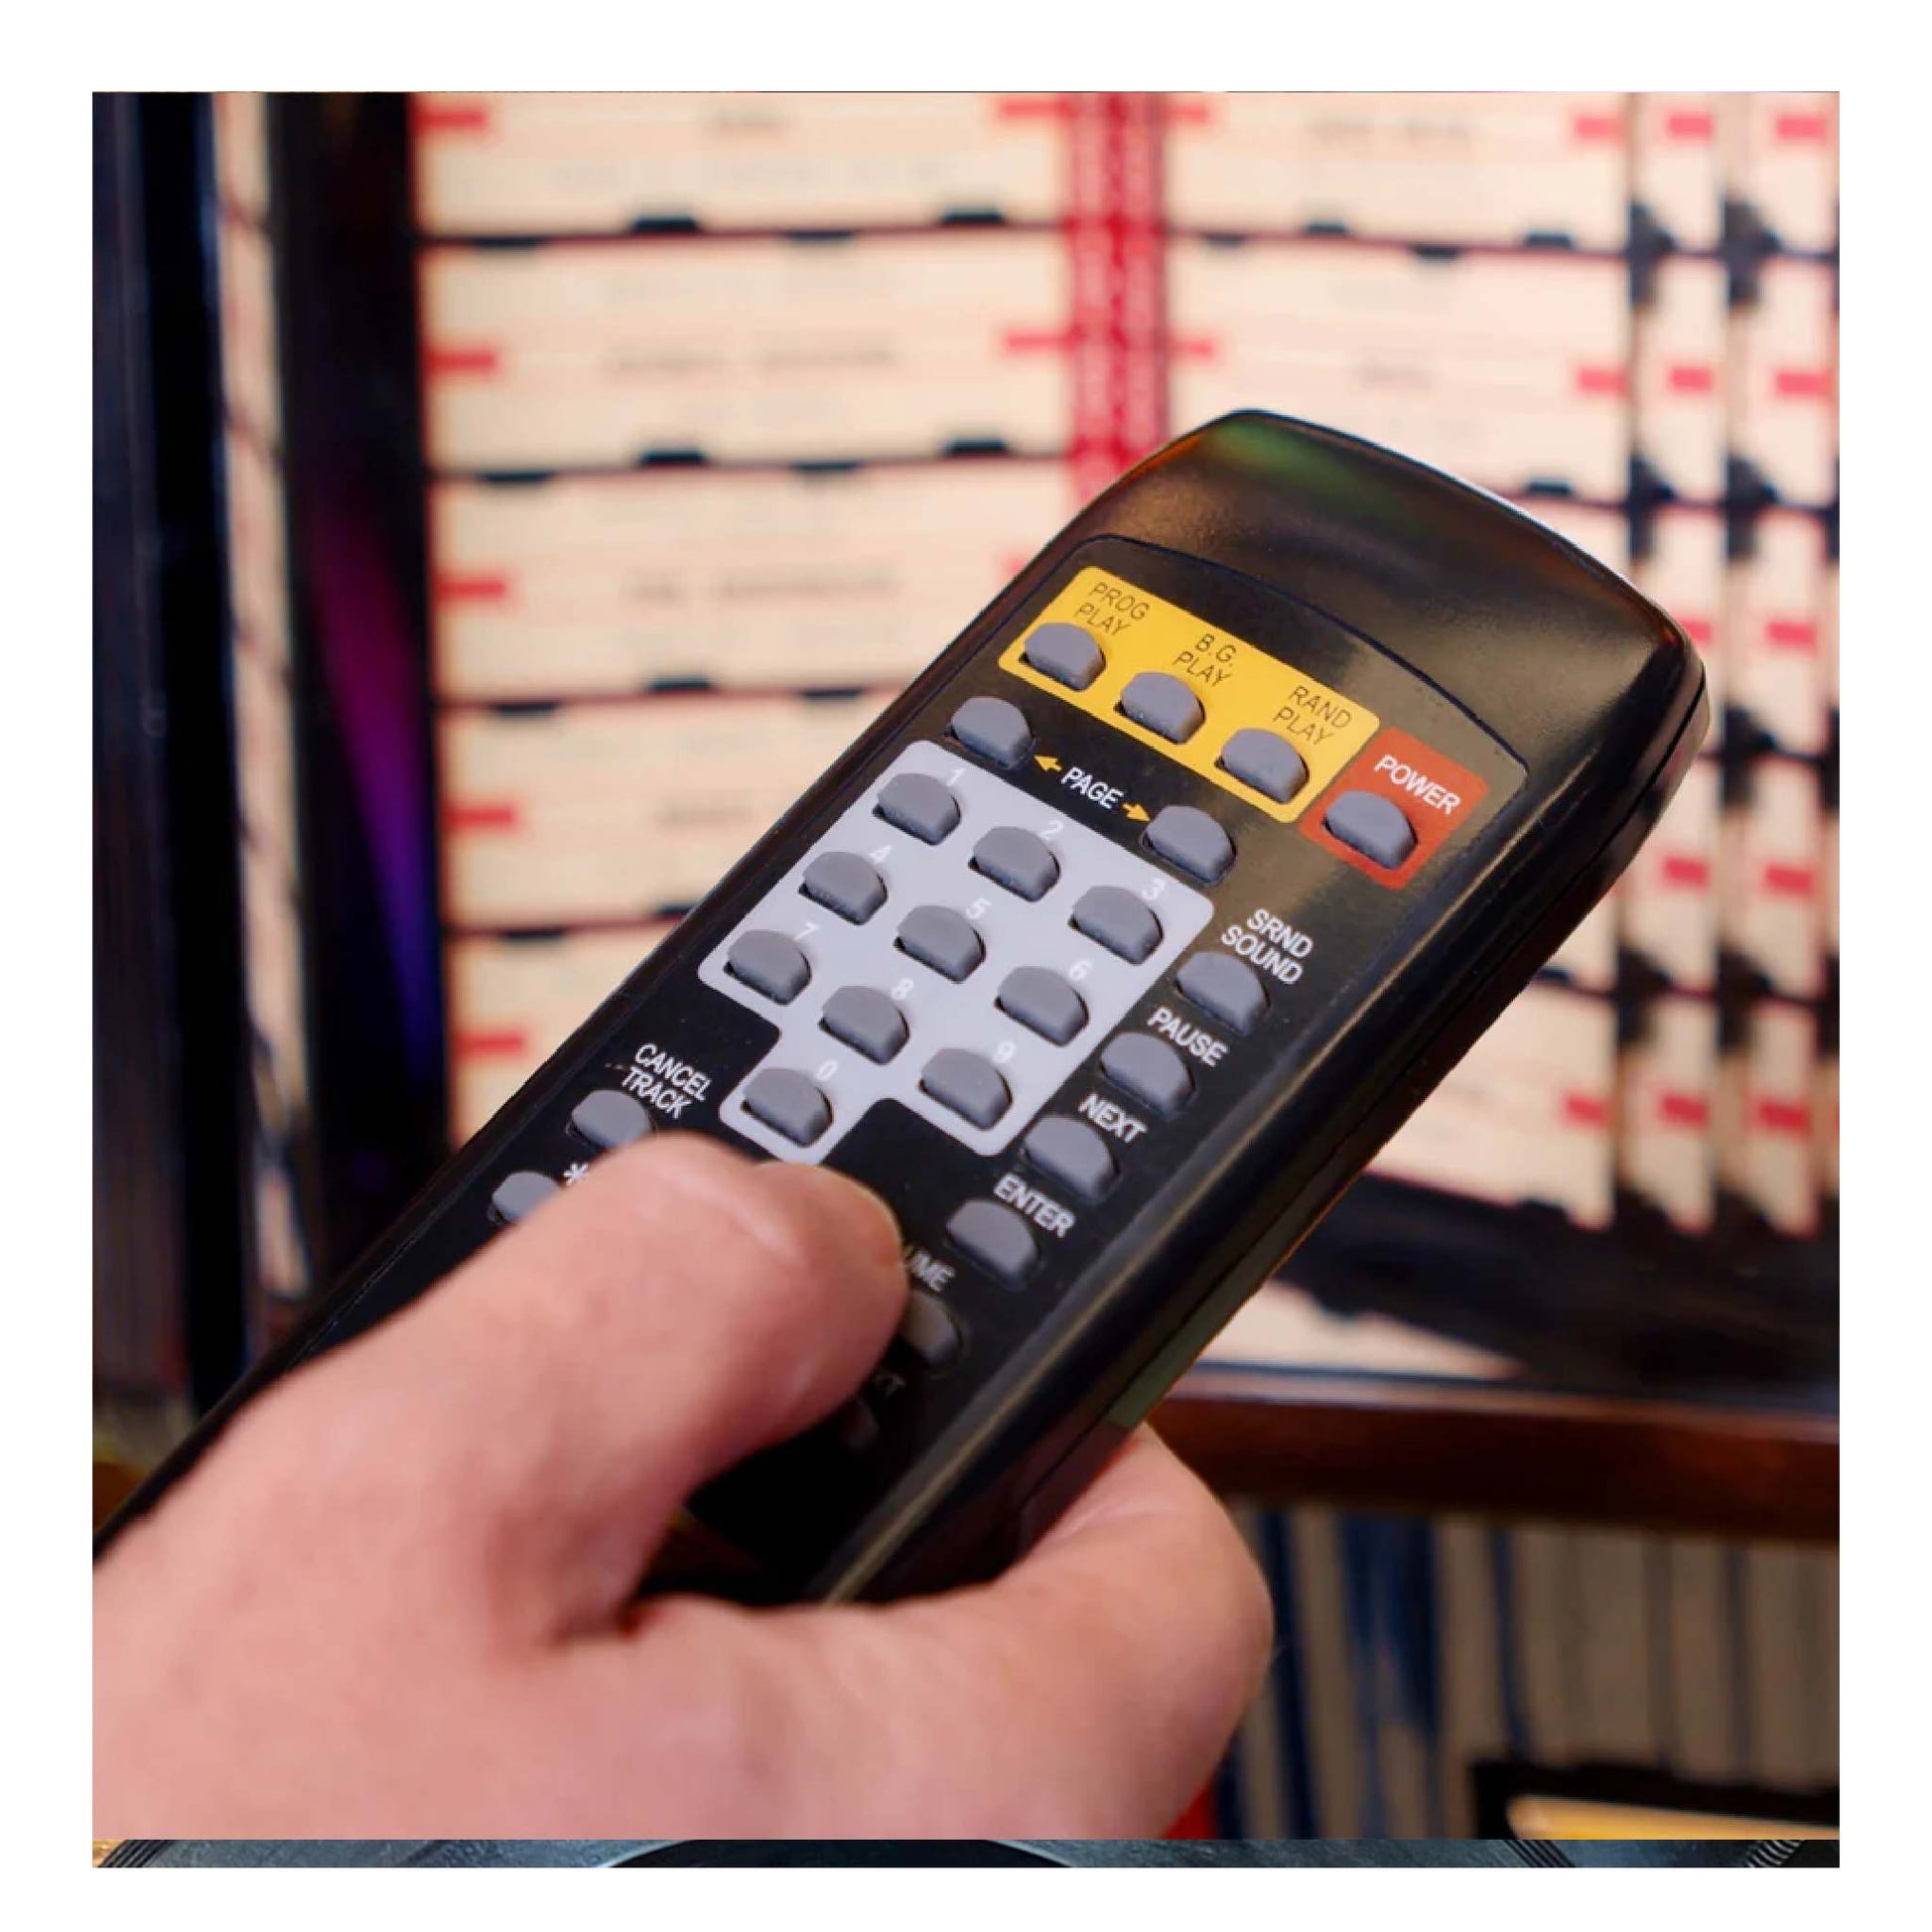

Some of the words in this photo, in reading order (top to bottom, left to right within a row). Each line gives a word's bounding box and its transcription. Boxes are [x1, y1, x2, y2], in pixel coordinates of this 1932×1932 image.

[1088, 581, 1152, 621] PROG
[1073, 603, 1132, 637] PLAY
[1194, 632, 1238, 663] B.G.
[1173, 651, 1234, 688] PLAY
[1288, 685, 1352, 730] RAND
[1272, 707, 1335, 746] PLAY
[946, 767, 967, 787] 1
[1060, 766, 1124, 810] PAGE
[1373, 754, 1462, 815] POWER
[1039, 819, 1065, 841] 2
[869, 844, 893, 865] 4
[1141, 878, 1166, 901] 3
[964, 897, 991, 921] 5
[794, 921, 820, 941] 7
[1246, 907, 1313, 959] SRND
[1068, 960, 1090, 982] 6
[1220, 924, 1304, 985] SOUND
[891, 979, 914, 1002] 8
[994, 1042, 1017, 1065] 9
[1147, 1006, 1229, 1067] PAUSE
[634, 1043, 712, 1102] CANCEL
[814, 1059, 838, 1082] 0
[621, 1066, 692, 1119] TRACK
[1077, 1092, 1148, 1144] NEXT
[994, 1173, 1076, 1238] ENTER
